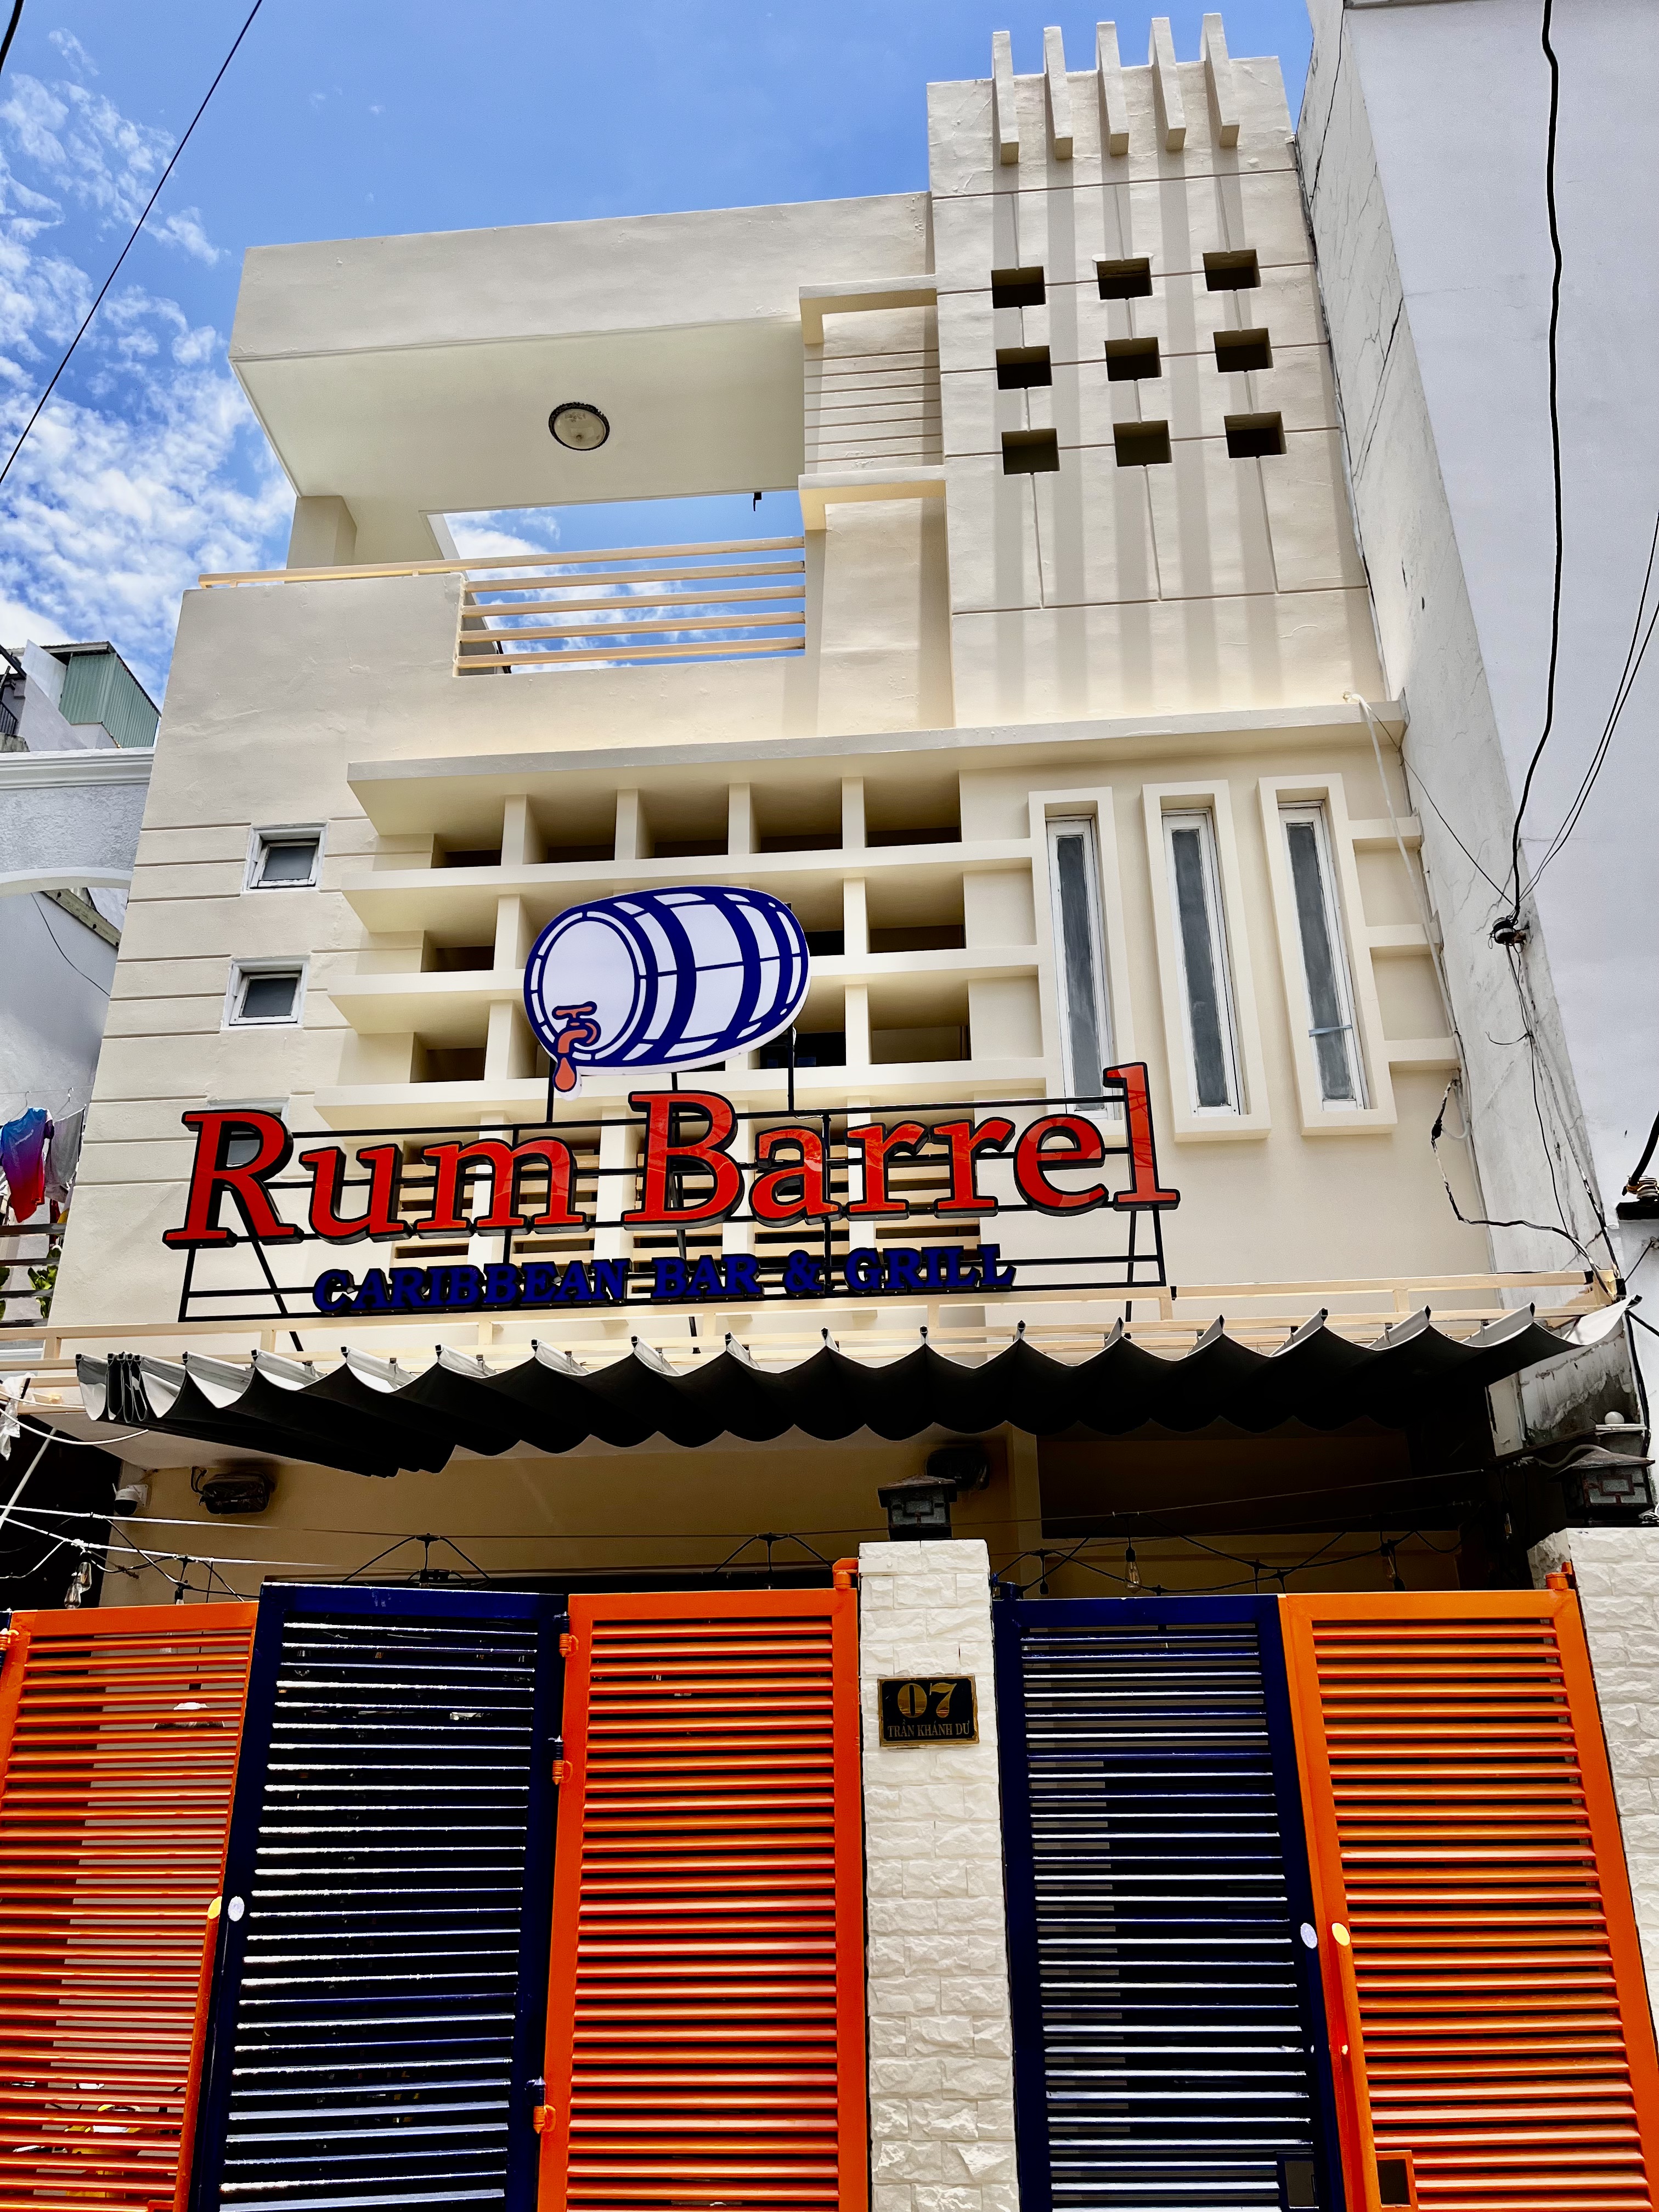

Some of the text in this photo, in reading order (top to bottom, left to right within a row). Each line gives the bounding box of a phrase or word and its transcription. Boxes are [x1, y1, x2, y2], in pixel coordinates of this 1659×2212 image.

[163, 1062, 1180, 1251] Rum Barrel
[313, 1244, 1017, 1316] CARIBBEAN BAR & GRILL
[898, 1683, 957, 1718] 07
